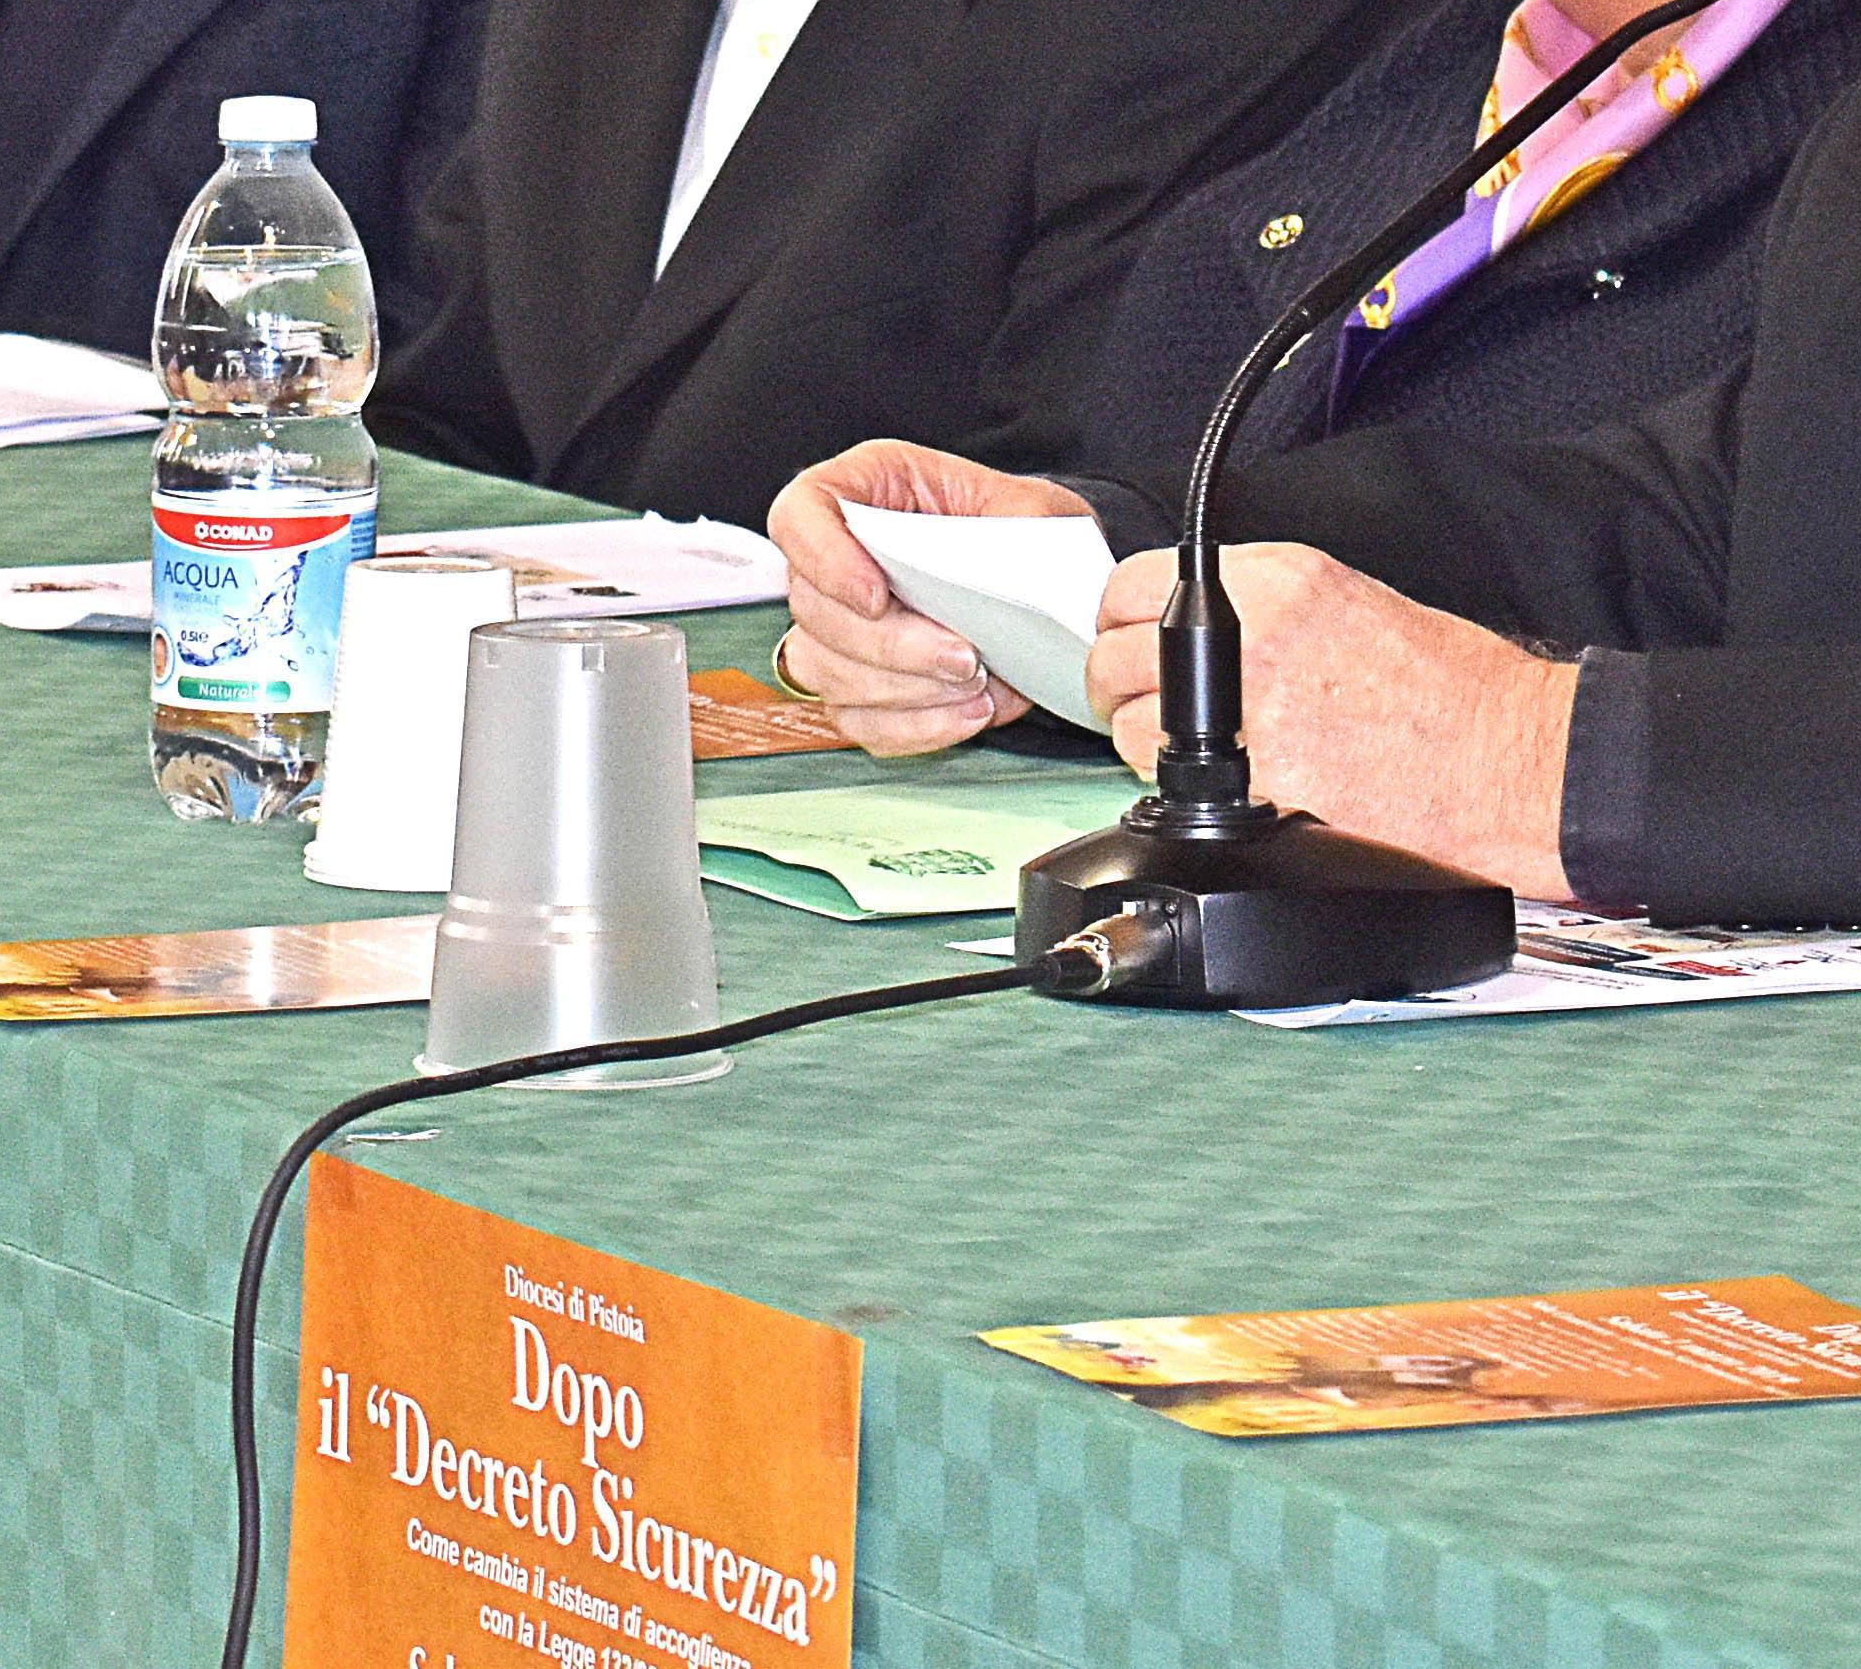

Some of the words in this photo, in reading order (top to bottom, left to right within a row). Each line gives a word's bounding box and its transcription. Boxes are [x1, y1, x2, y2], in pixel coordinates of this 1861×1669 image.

[163, 560, 239, 591] ACQUA
[504, 1264, 565, 1315] Diocesi
[569, 1285, 585, 1322] di
[588, 1293, 646, 1344] Pistoia
[509, 1315, 644, 1466] Dopo
[317, 1366, 351, 1463] il
[366, 1383, 577, 1547] “Decreto
[590, 1468, 836, 1646] Sicurezza”
[406, 1517, 461, 1566] Come
[463, 1546, 530, 1594] cambia
[532, 1565, 545, 1600] il
[548, 1576, 620, 1630] sistema
[623, 1604, 642, 1639] di
[479, 1604, 514, 1640] con
[517, 1611, 535, 1648] la
[538, 1619, 597, 1669] Legge
